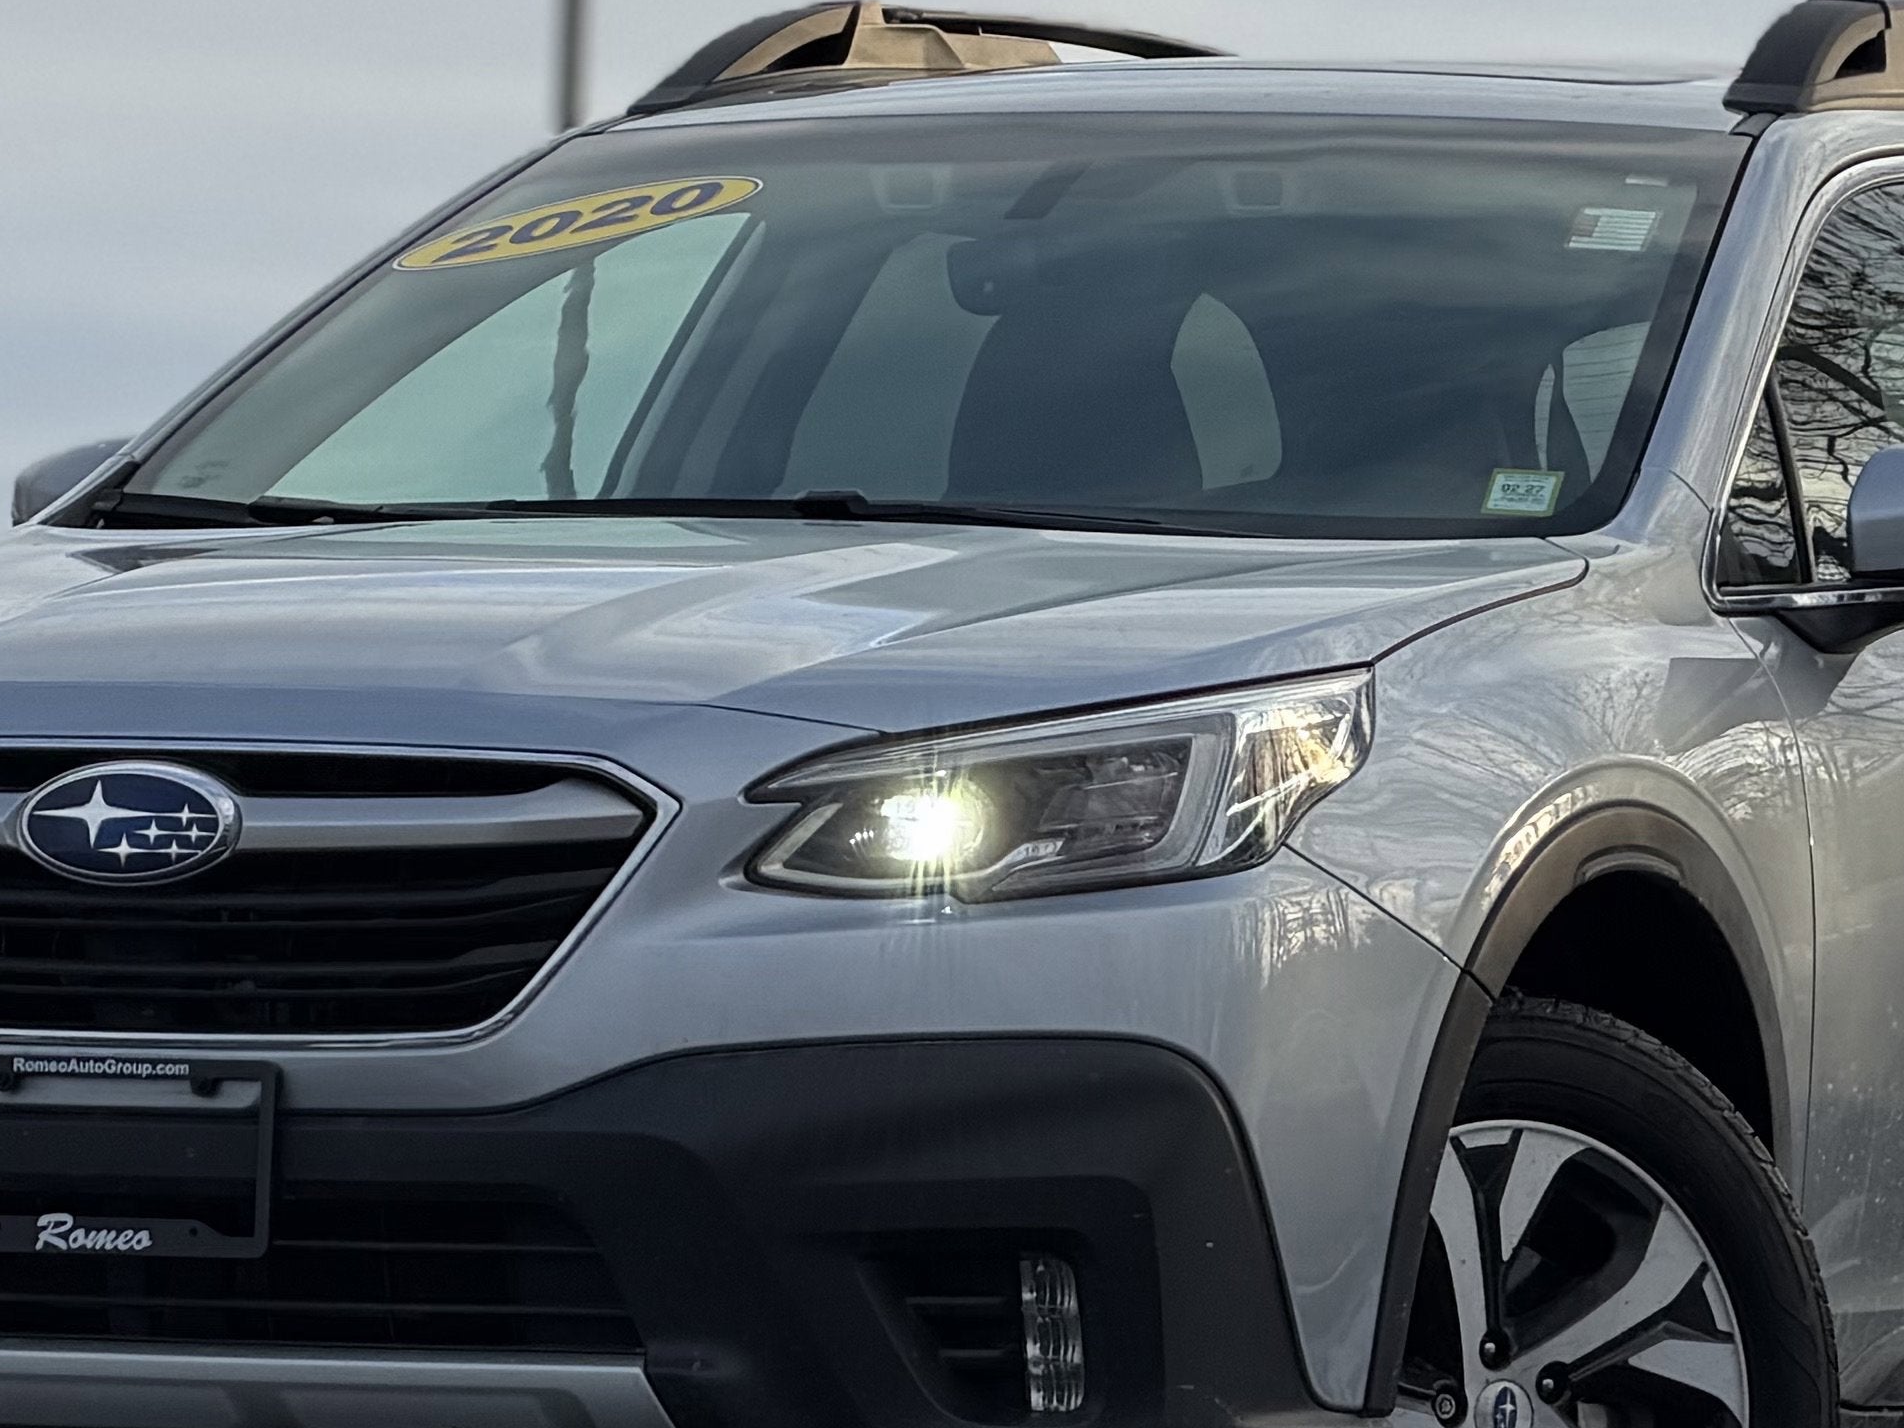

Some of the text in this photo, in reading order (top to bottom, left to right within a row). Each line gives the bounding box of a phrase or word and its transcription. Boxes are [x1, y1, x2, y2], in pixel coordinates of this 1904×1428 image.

[430, 181, 723, 264] 2020
[13, 1058, 189, 1076] RomeoAutoGroup.com
[36, 1213, 152, 1251] Romeo
